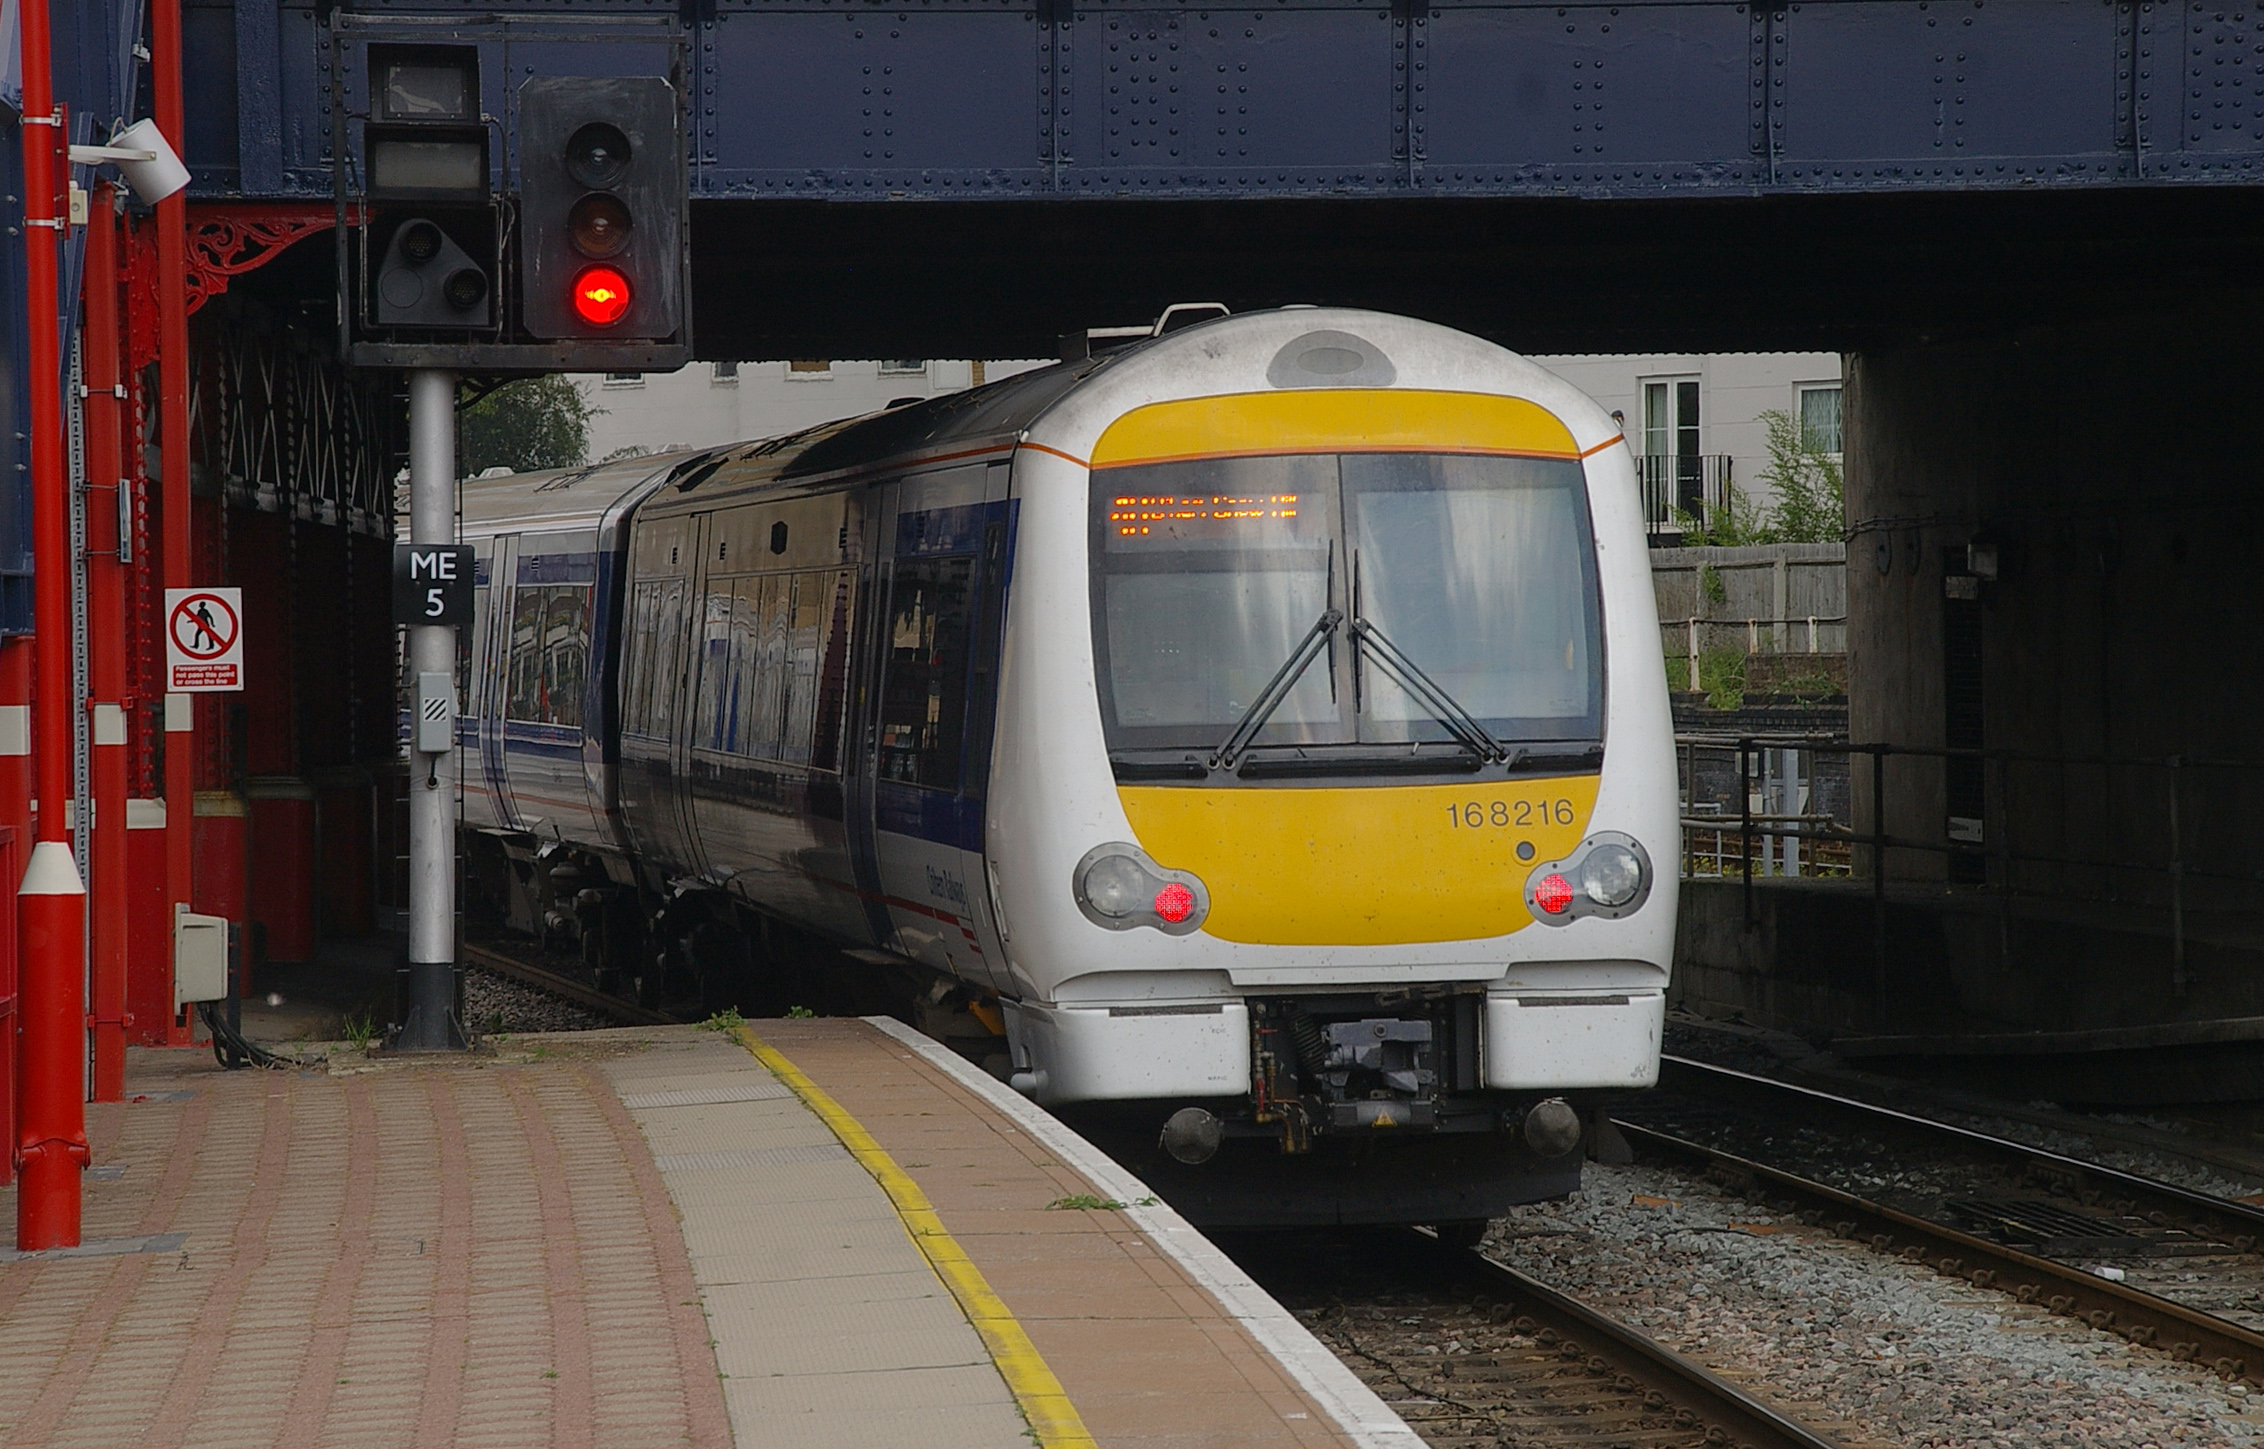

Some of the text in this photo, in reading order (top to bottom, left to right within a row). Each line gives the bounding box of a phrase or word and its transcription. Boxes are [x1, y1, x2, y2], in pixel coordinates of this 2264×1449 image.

[411, 552, 457, 579] ME
[425, 588, 444, 616] 5
[1446, 798, 1574, 828] 168216
